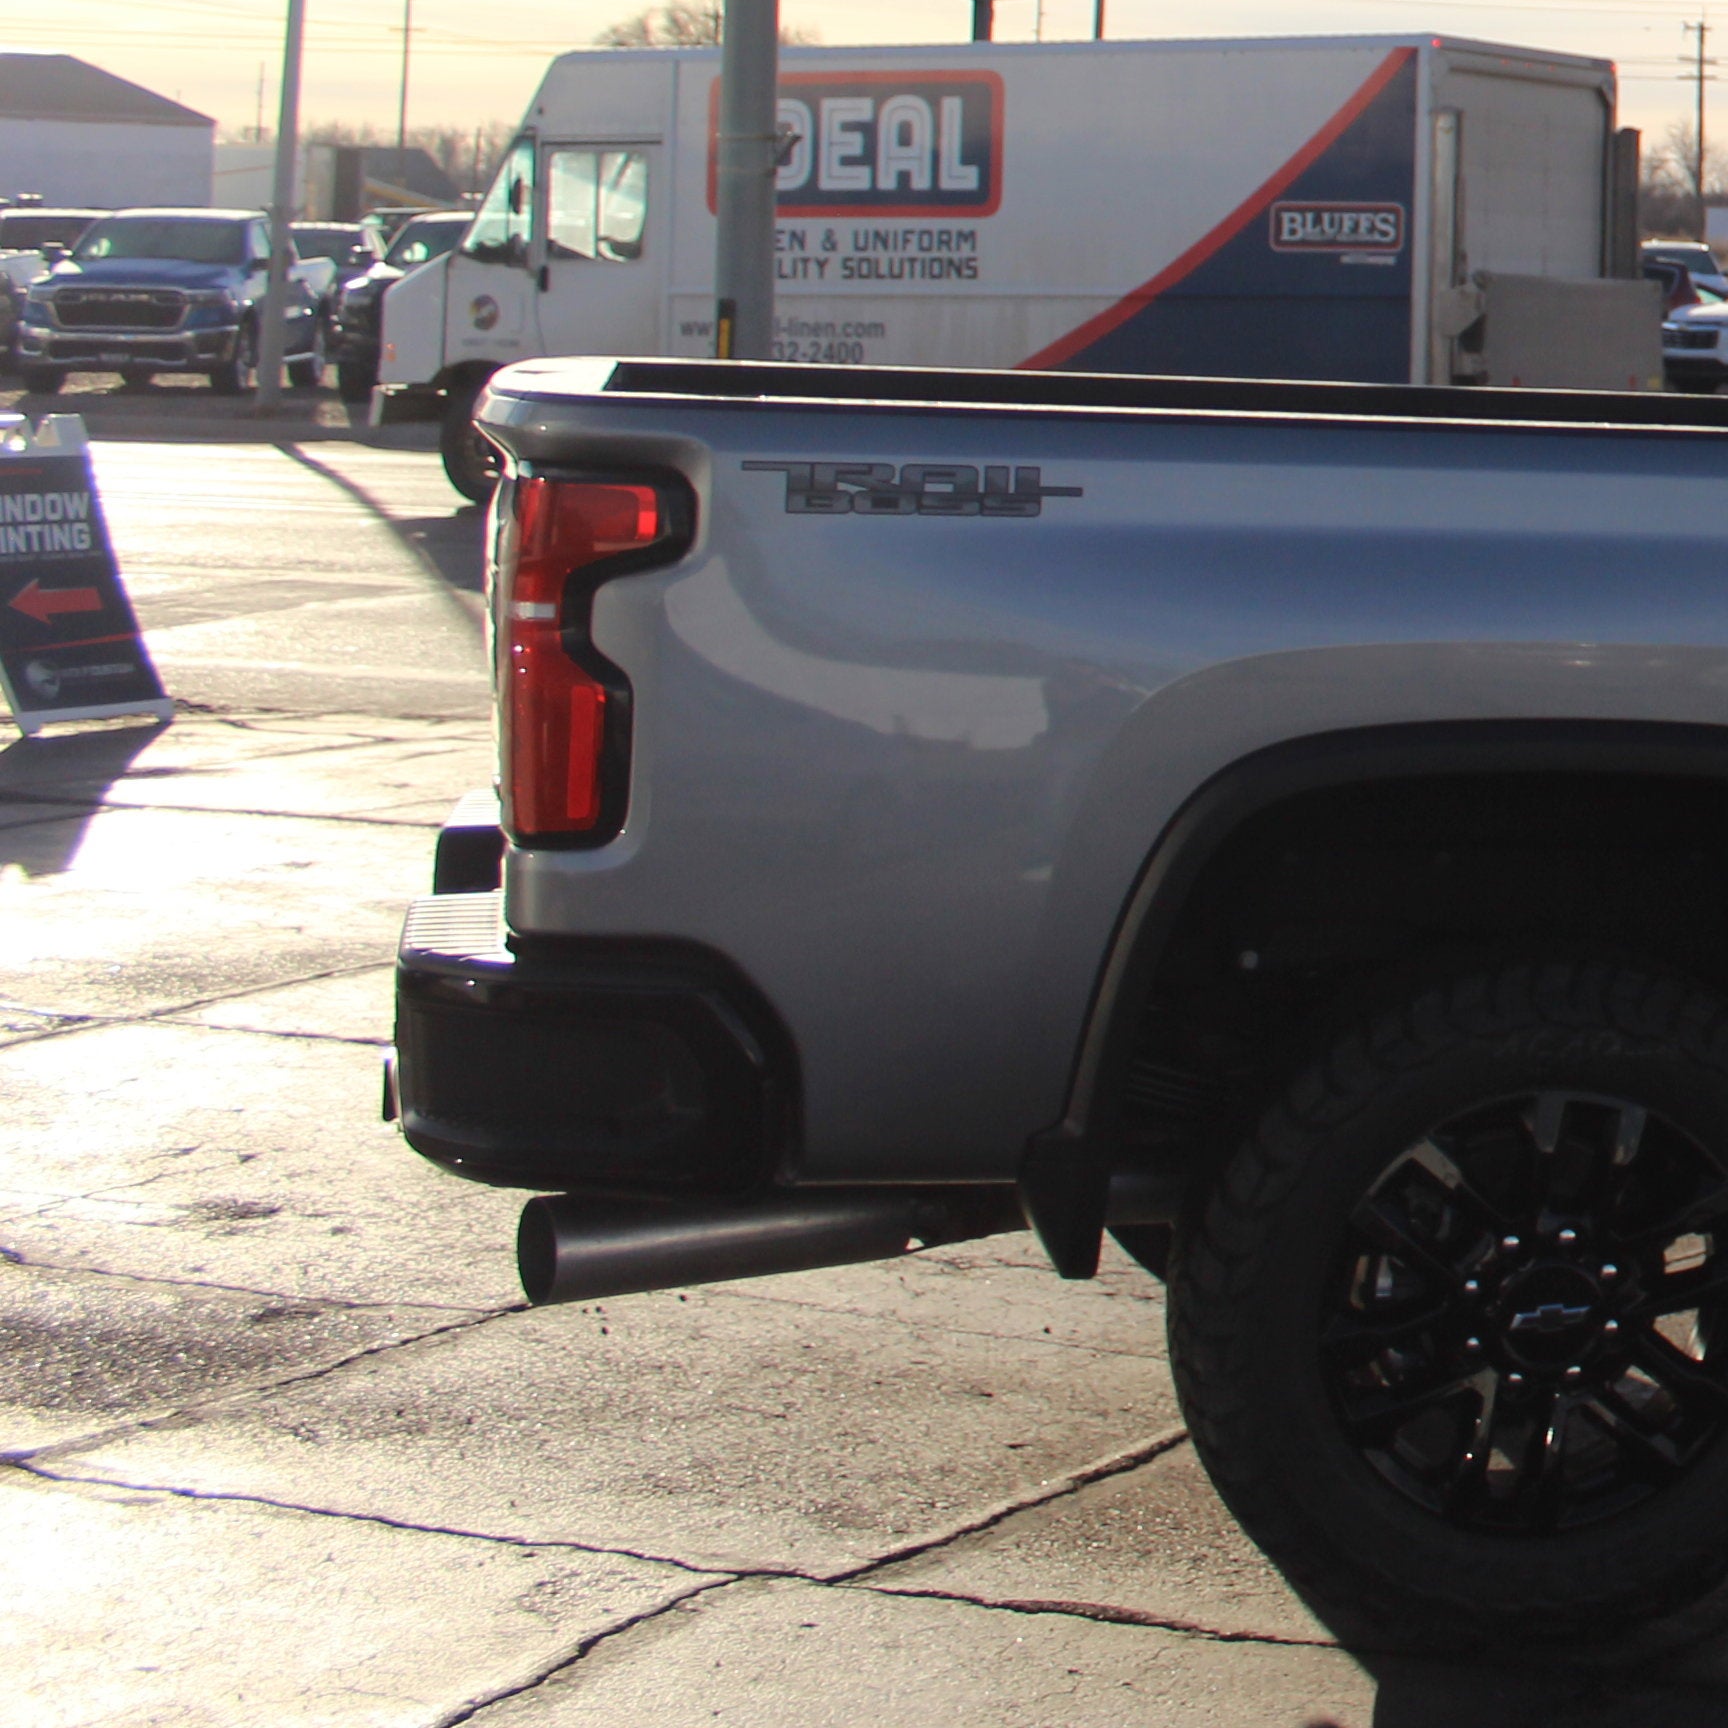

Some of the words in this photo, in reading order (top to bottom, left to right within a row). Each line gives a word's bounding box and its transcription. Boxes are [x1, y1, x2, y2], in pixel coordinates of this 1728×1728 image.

[776, 94, 981, 191] DEAL
[821, 230, 838, 252] &
[854, 229, 977, 252] UNIFORM
[1280, 212, 1396, 242] BLUFFS
[775, 256, 830, 280] LITY
[841, 256, 979, 280] SOLUTIONS
[741, 460, 1083, 498] TRAIL
[0, 492, 90, 523] NDOW
[0, 522, 92, 554] INTING
